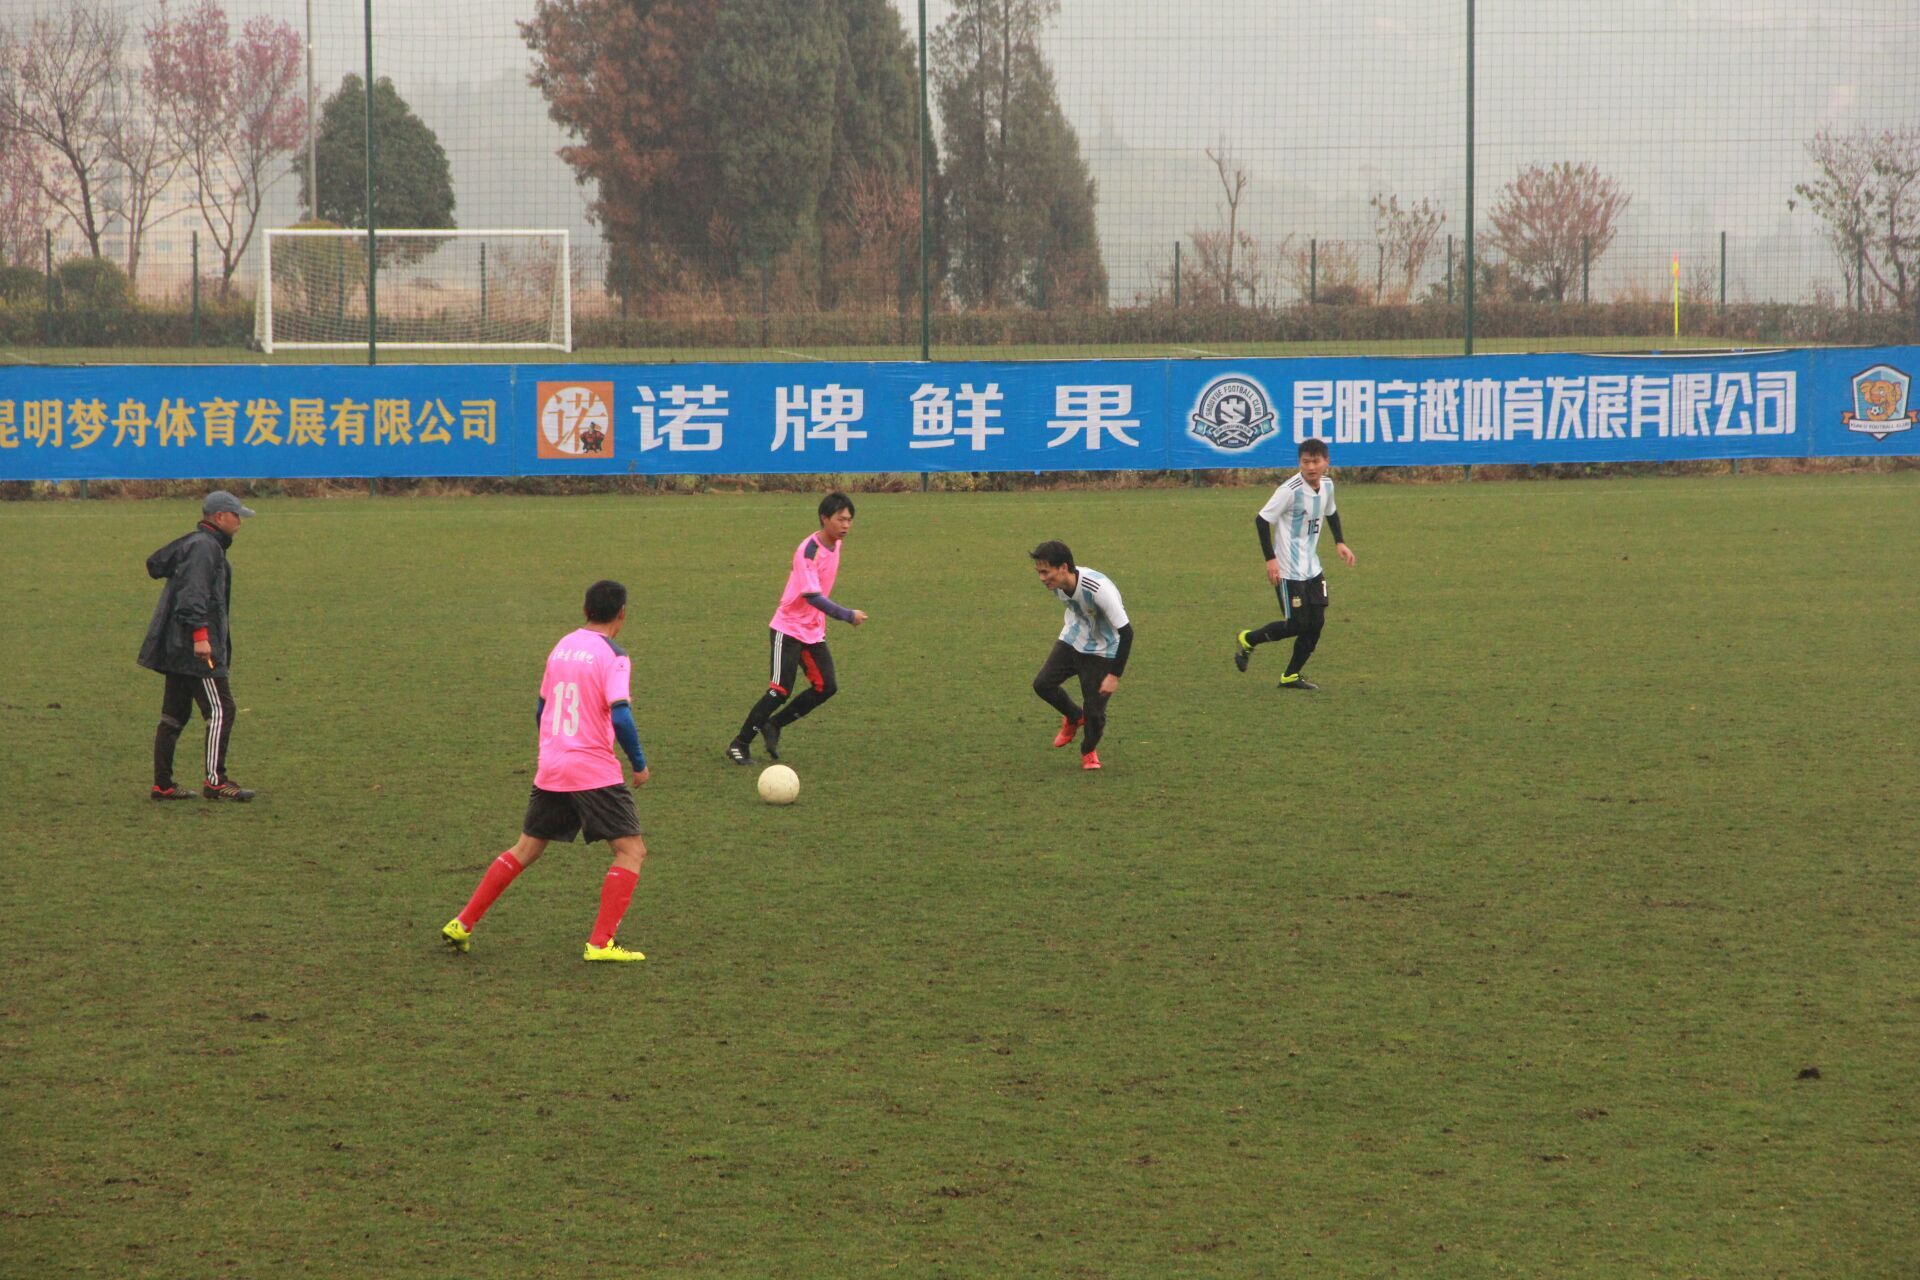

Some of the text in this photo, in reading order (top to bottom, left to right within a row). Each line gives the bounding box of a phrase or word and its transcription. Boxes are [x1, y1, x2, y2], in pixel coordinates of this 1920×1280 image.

[632, 383, 1141, 452] 诺牌鲜果
[1223, 385, 1254, 400] FOOTBALL
[1252, 399, 1262, 416] CLUB
[1293, 370, 1797, 443] 昆明守越体育发展有限公司
[552, 681, 579, 736] 13
